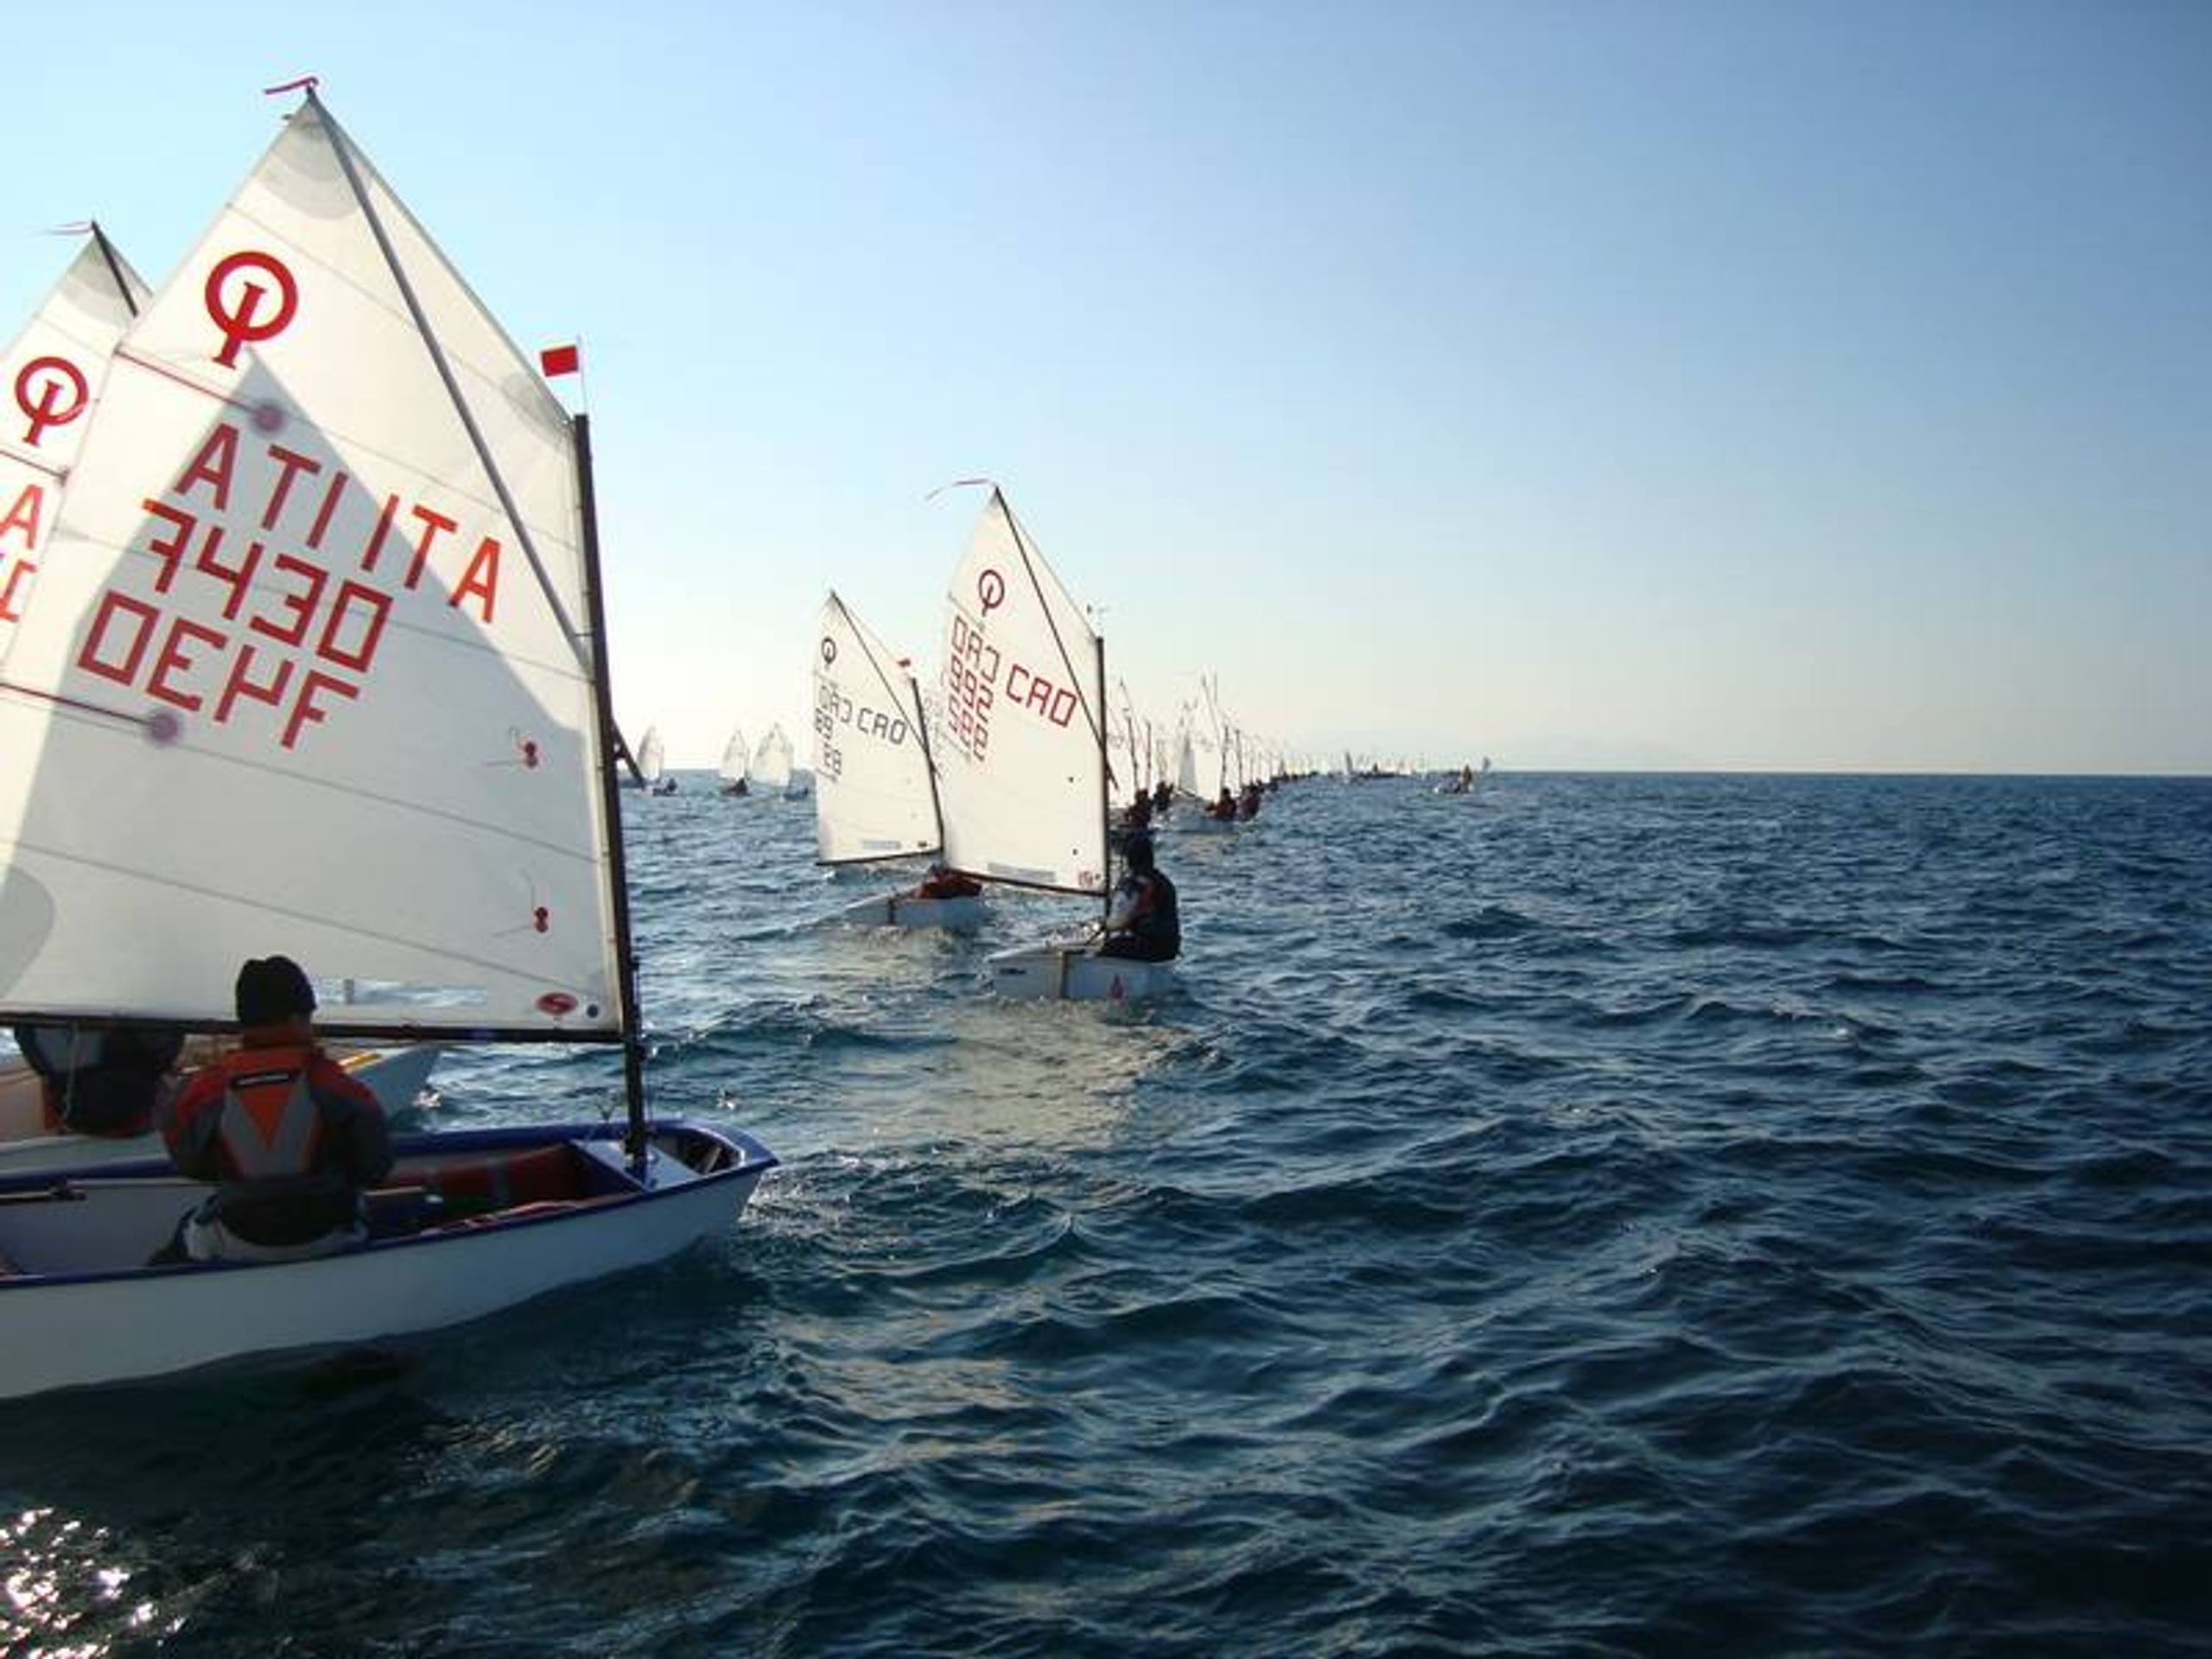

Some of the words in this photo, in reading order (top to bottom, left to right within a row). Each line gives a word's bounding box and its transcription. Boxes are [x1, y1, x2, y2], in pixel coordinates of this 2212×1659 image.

[141, 499, 396, 673] 7430
[363, 494, 503, 622] ITA
[857, 707, 907, 745] CRO
[1006, 664, 1077, 728] CRO
